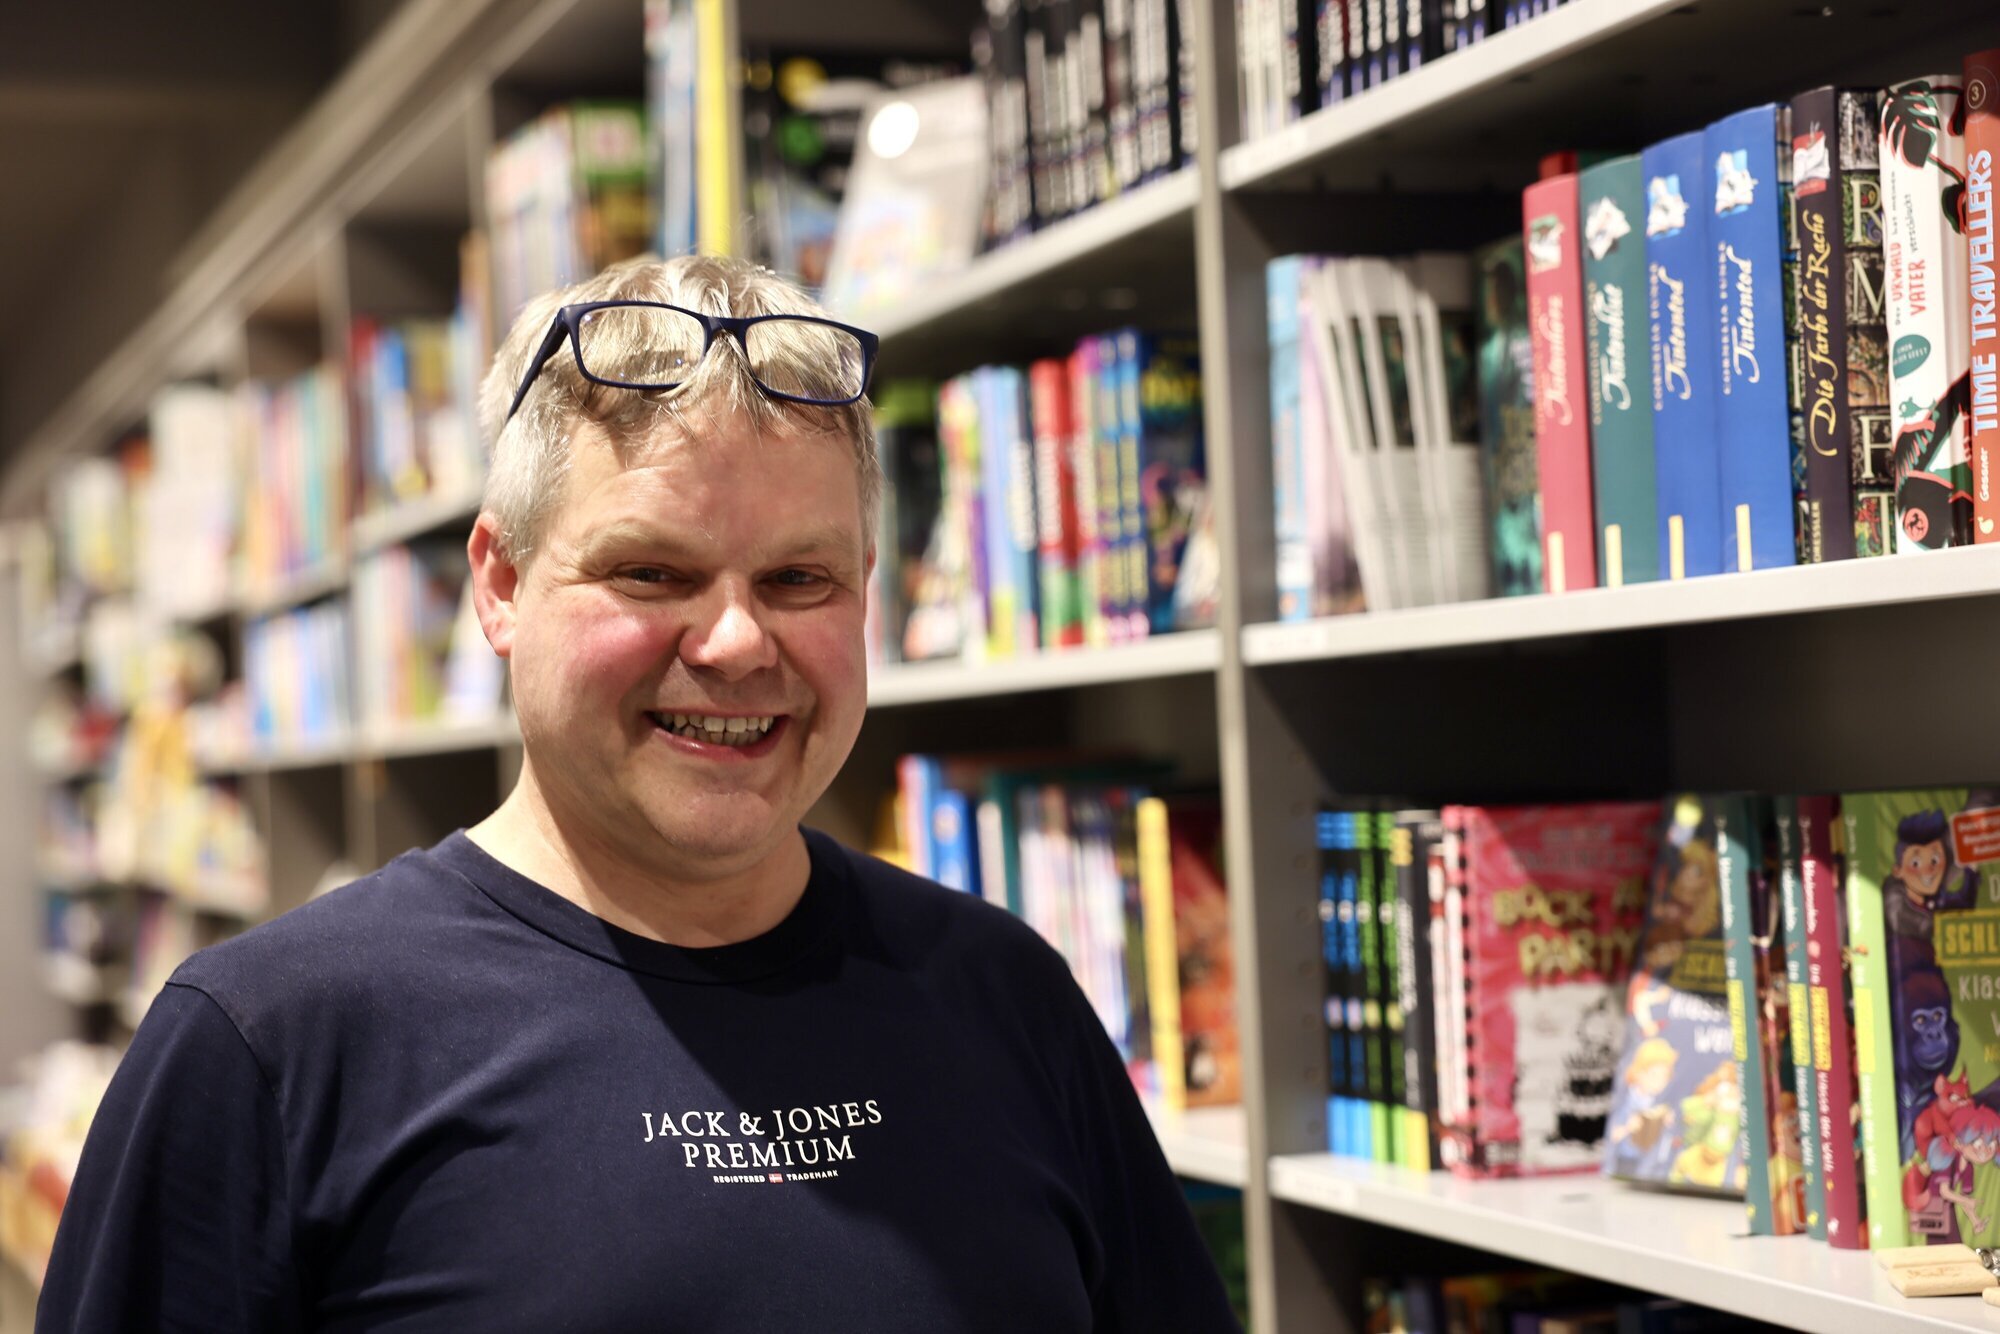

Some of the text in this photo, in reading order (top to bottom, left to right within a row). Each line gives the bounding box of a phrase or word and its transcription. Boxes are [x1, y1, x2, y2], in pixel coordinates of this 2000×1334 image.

[1971, 85, 1981, 102] 3
[1890, 242, 1904, 302] URWALD
[1908, 258, 1927, 316] VATER
[1967, 149, 1998, 437] TIME TRAVELLERS
[1803, 208, 1839, 457] Die Farbe der Rache
[1979, 447, 1991, 502] Gessner
[1810, 501, 1822, 563] DRESSLER
[641, 1100, 882, 1142] JACK & JONES
[682, 1135, 856, 1168] PREMIUM
[713, 1170, 839, 1184] REGISTERED TRADEMARK
